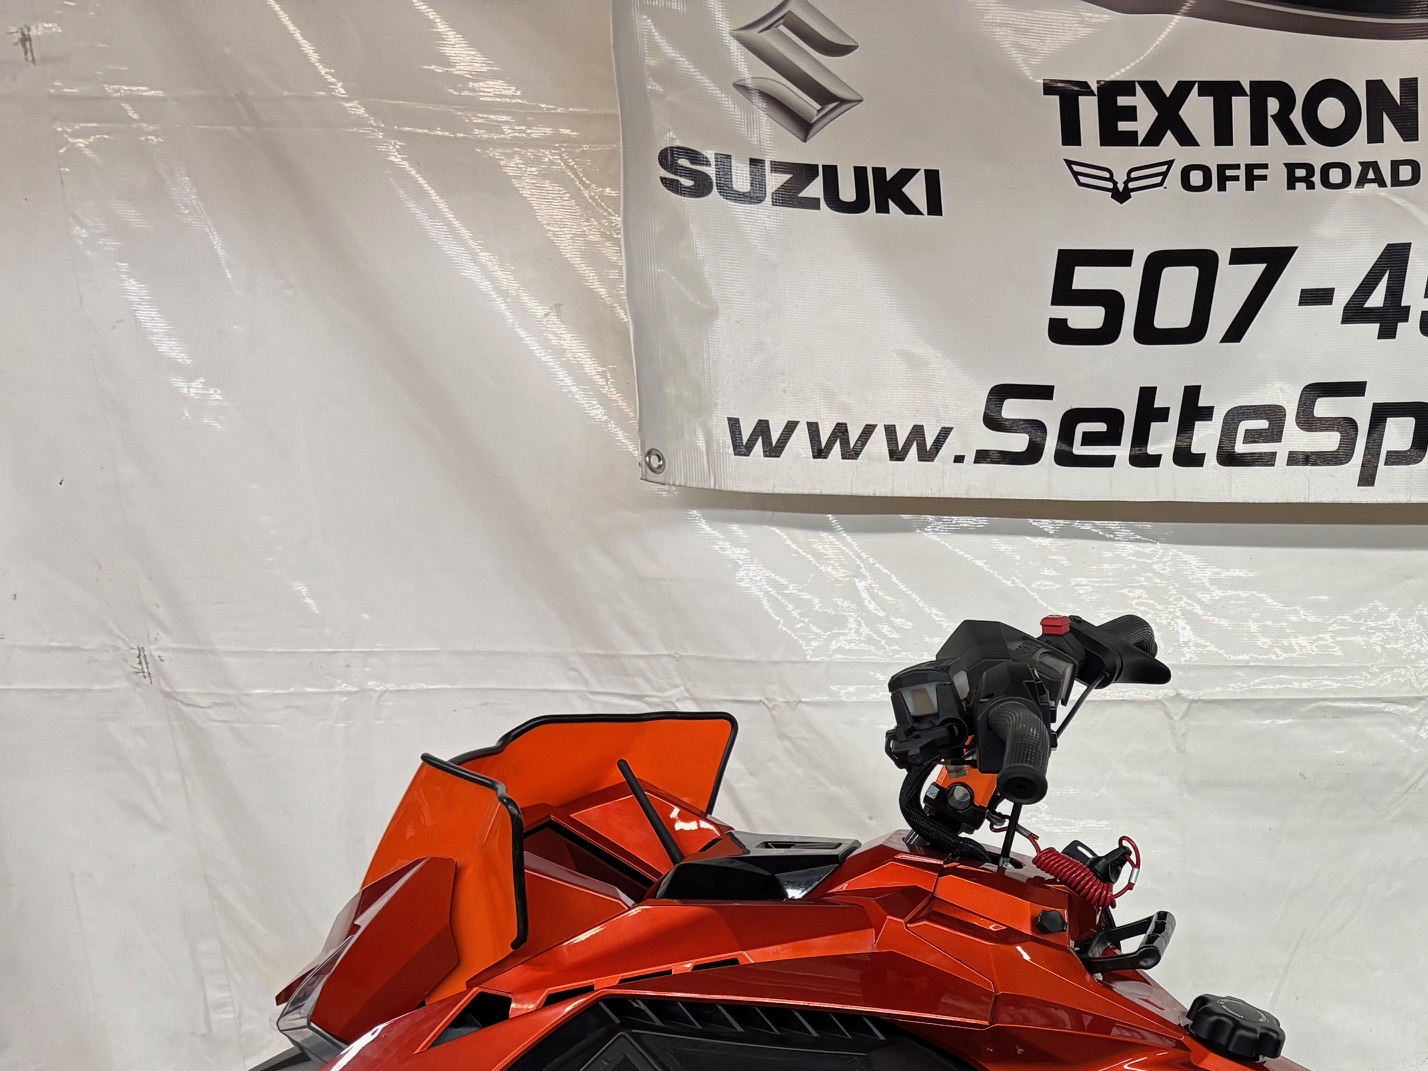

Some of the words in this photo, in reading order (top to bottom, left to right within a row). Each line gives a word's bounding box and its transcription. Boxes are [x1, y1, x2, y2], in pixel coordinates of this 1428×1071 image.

[1042, 77, 1420, 147] TEXTRON
[658, 145, 944, 217] SUZUKI
[1180, 162, 1270, 192] OFF
[1283, 158, 1422, 191] ROAD
